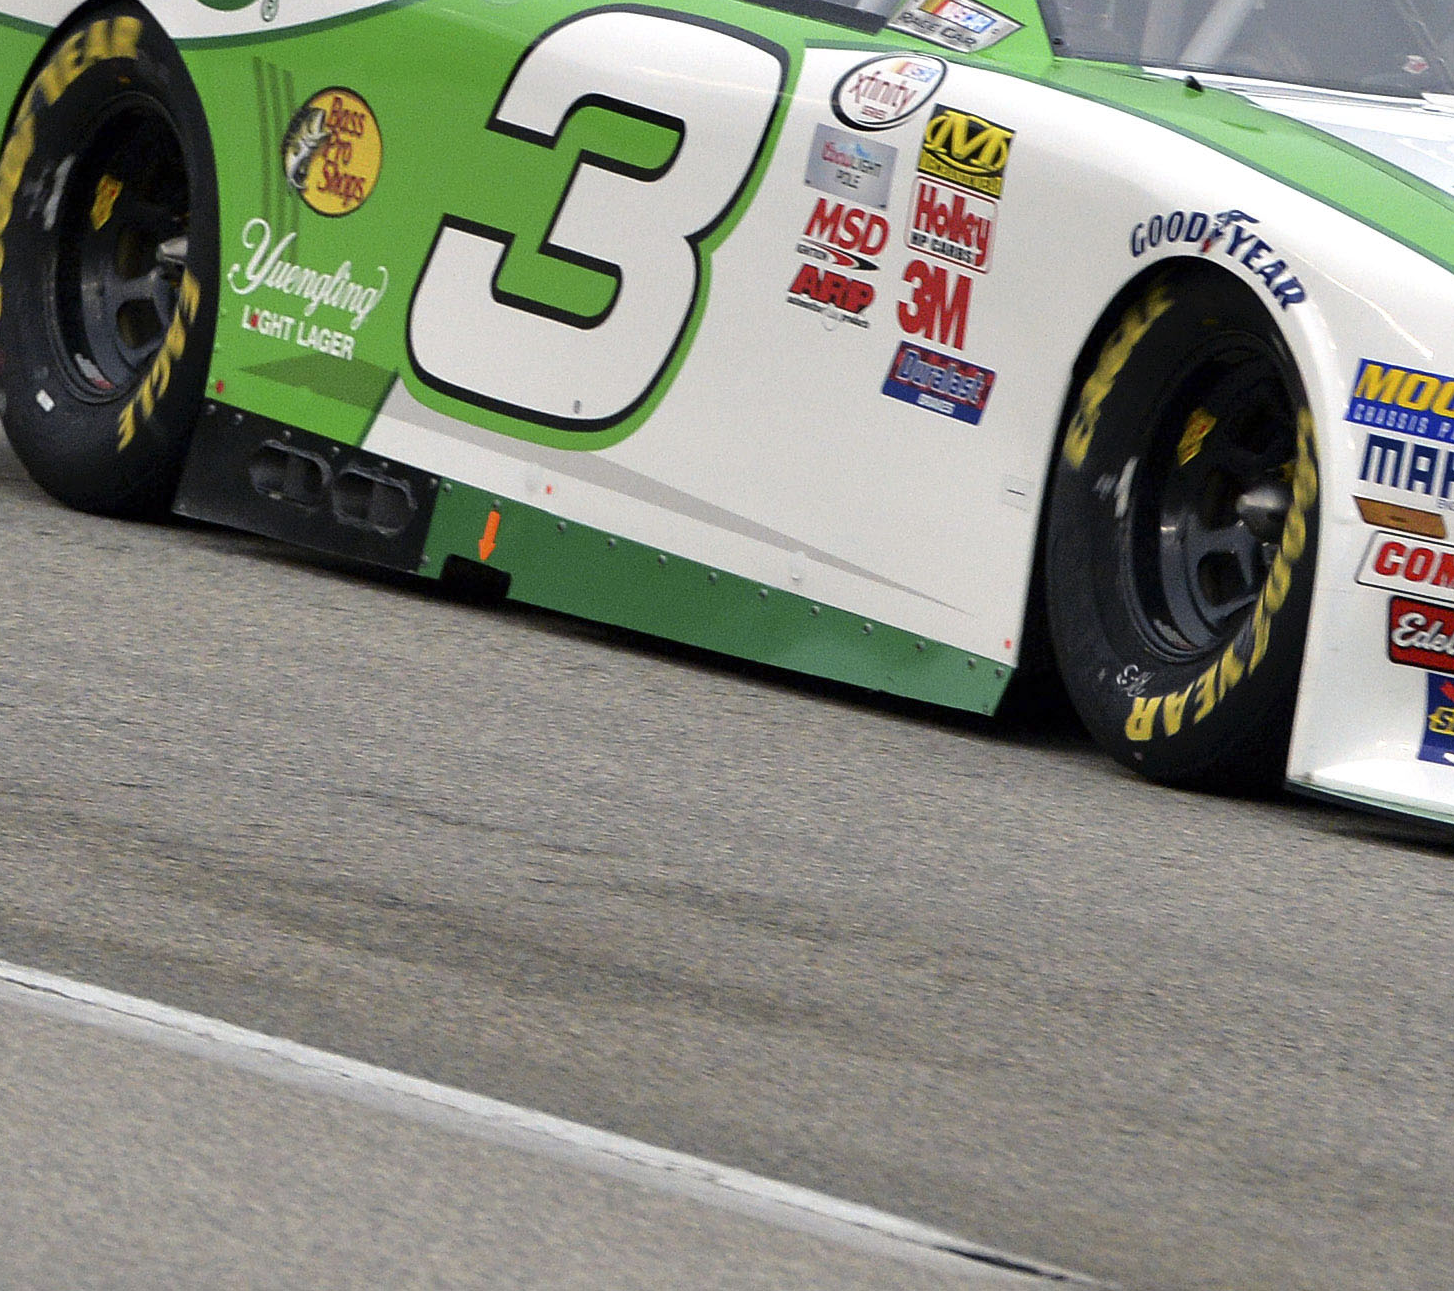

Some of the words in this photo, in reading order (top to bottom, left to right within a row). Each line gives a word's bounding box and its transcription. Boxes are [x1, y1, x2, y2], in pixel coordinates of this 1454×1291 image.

[326, 96, 366, 138] Bass
[322, 132, 353, 166] Pro
[318, 159, 367, 207] Shops
[405, 3, 791, 433] 3
[805, 198, 889, 256] MSD
[914, 183, 991, 267] Holley
[227, 217, 390, 330] Yuengling
[789, 263, 876, 314] ARP
[1131, 209, 1307, 311] GOODYEAR
[241, 304, 296, 341] LIGHT
[297, 320, 356, 361] LAGER
[897, 259, 973, 351] 3M
[1352, 403, 1429, 434] CHASSIS
